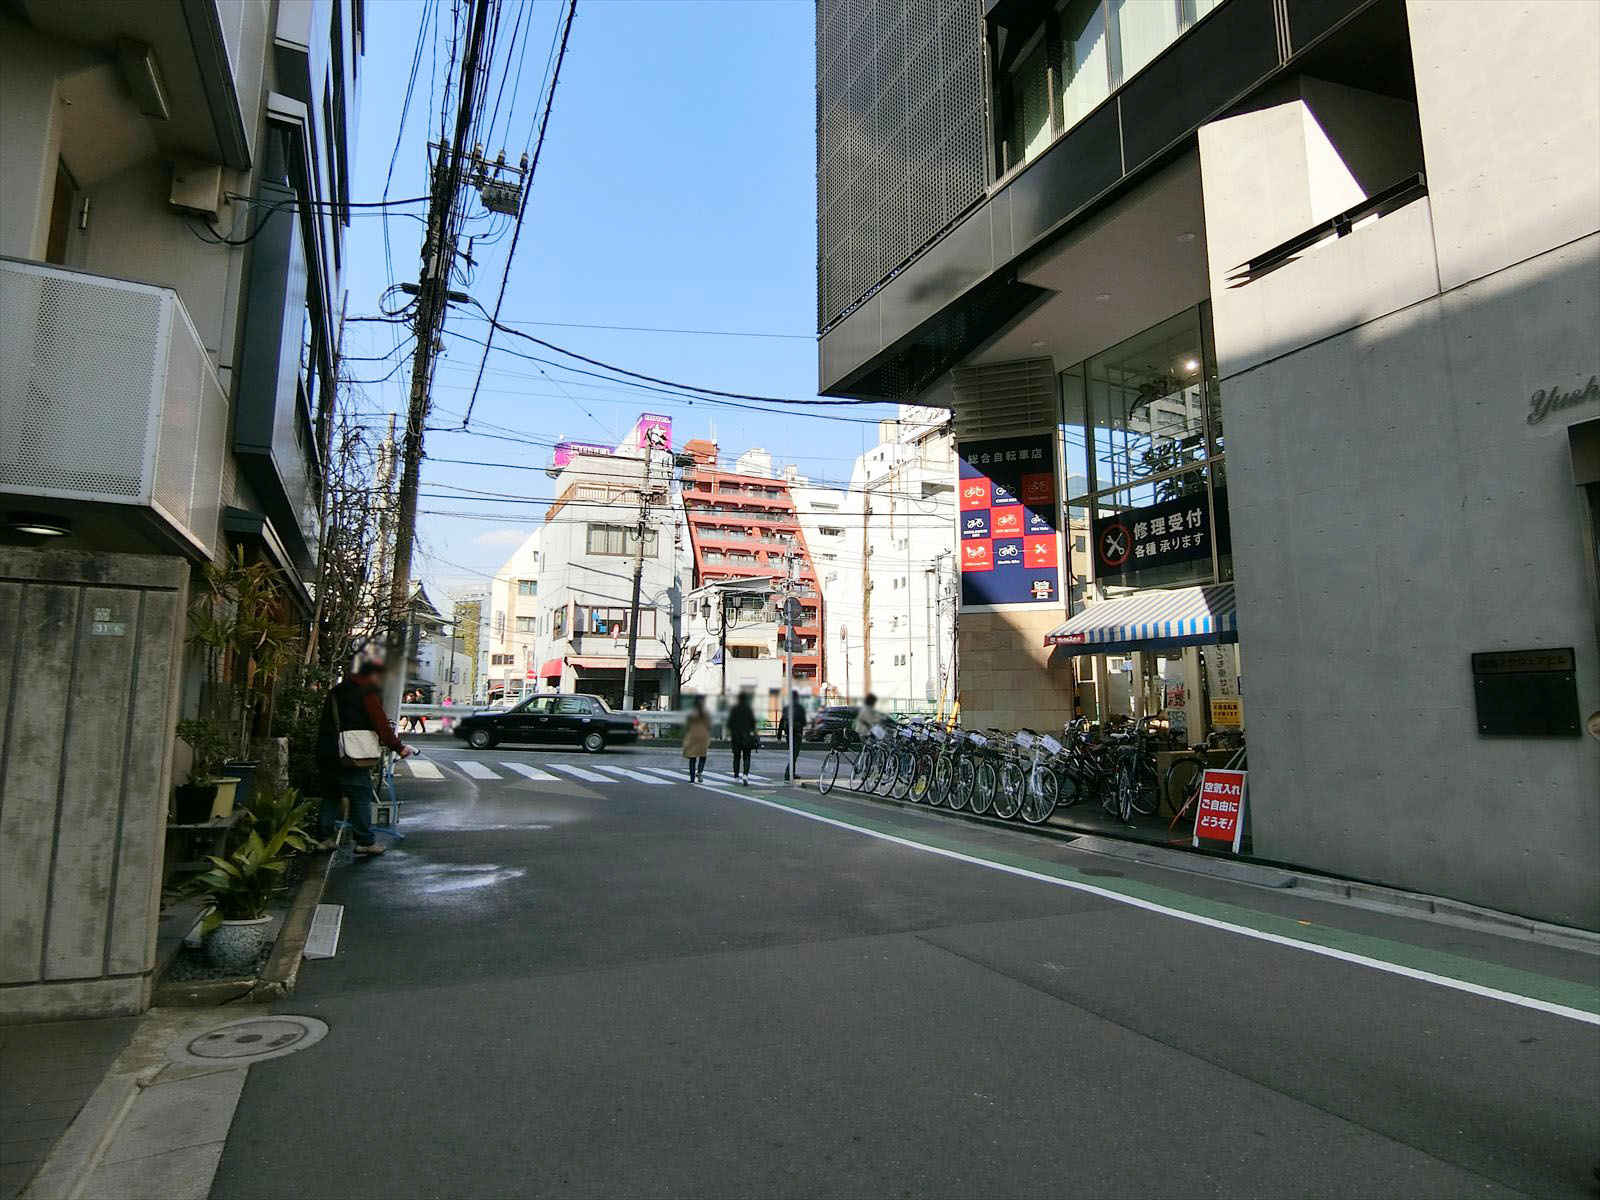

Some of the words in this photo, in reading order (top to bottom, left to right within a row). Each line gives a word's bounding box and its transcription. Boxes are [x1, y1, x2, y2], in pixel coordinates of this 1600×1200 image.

[967, 448, 1043, 465] 総合自転車店
[1133, 507, 1203, 541] 修理受付
[1135, 541, 1156, 558] 各種
[1159, 532, 1204, 553] 承ります
[1203, 782, 1240, 795] 空気入れ
[1201, 799, 1238, 813] ご自由に
[1200, 815, 1234, 830] どうぞ!
